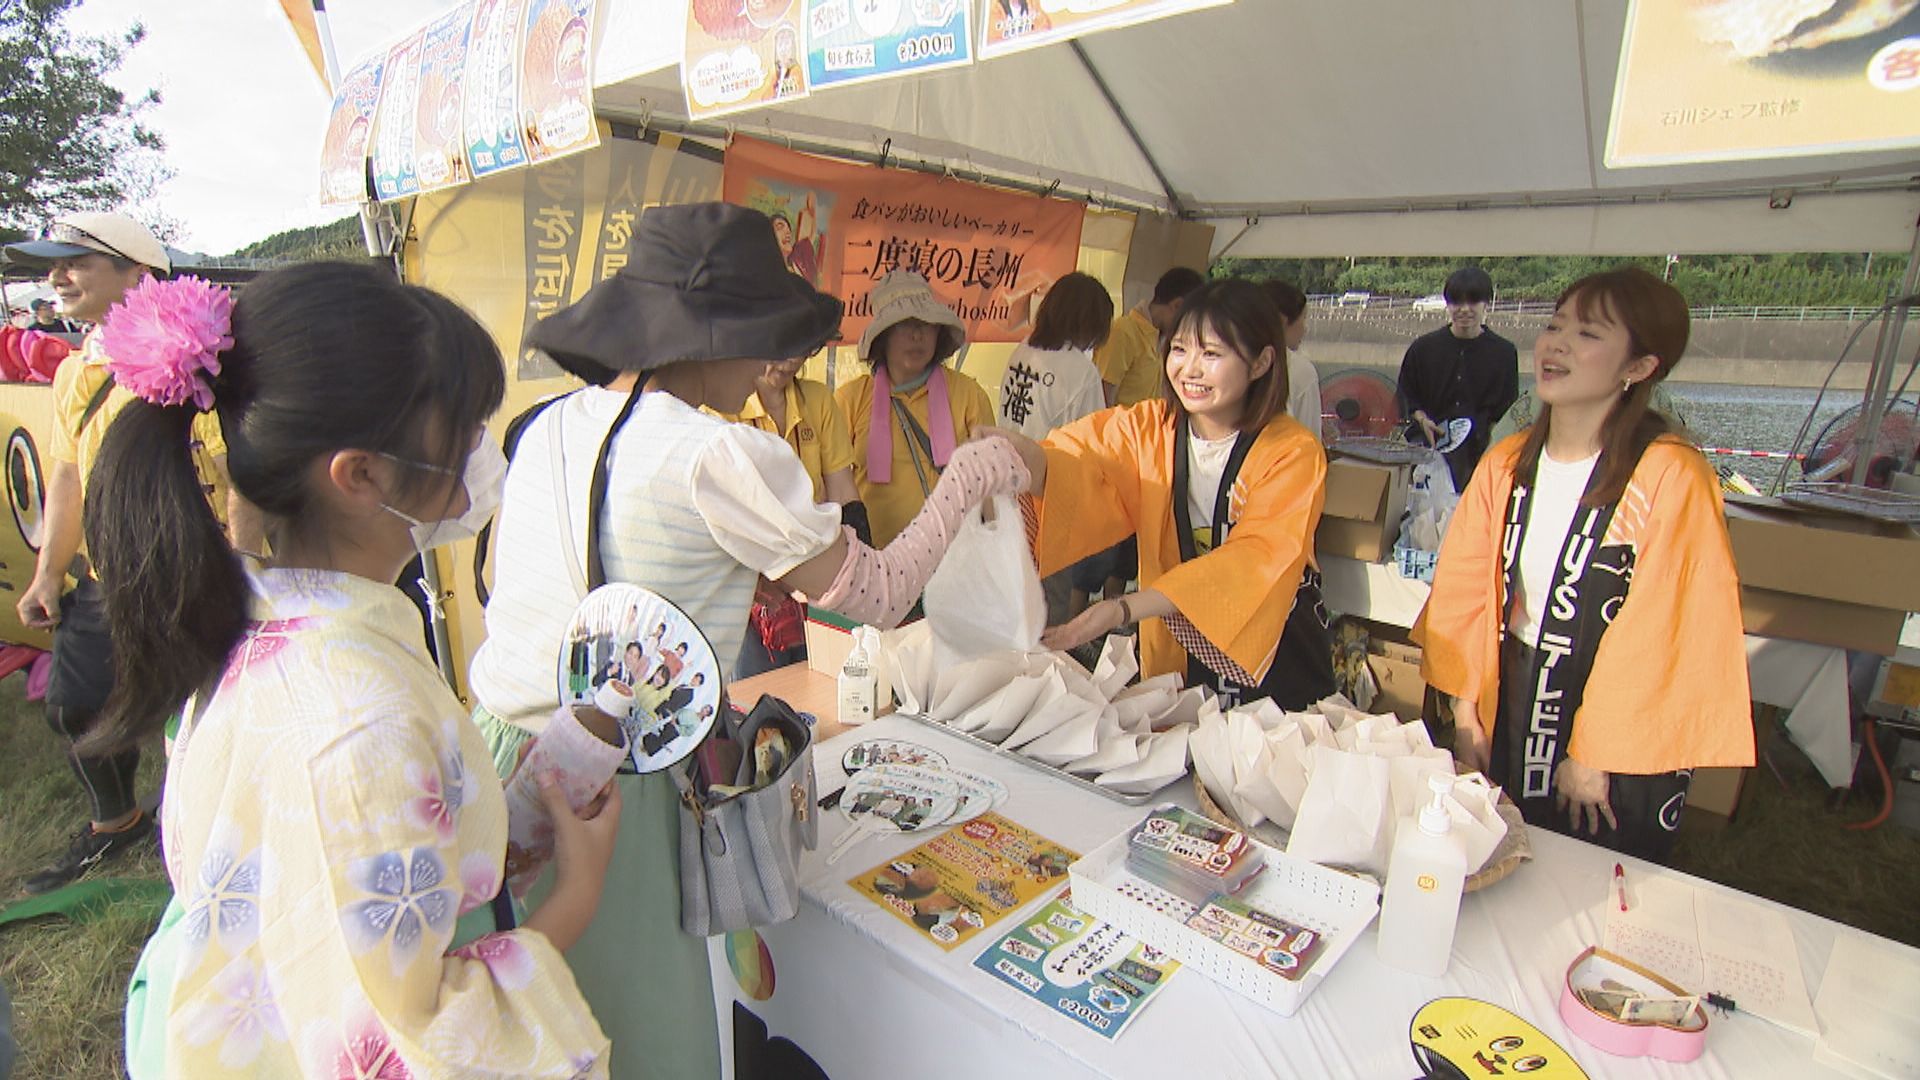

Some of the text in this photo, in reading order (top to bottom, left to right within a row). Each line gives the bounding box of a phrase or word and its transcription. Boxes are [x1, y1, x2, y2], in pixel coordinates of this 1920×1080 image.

[1661, 99, 1800, 126] 石川シェフ監修
[852, 197, 1034, 239] 食パンがおいしいベーカリー
[841, 236, 1025, 289] 二度寝の長州
